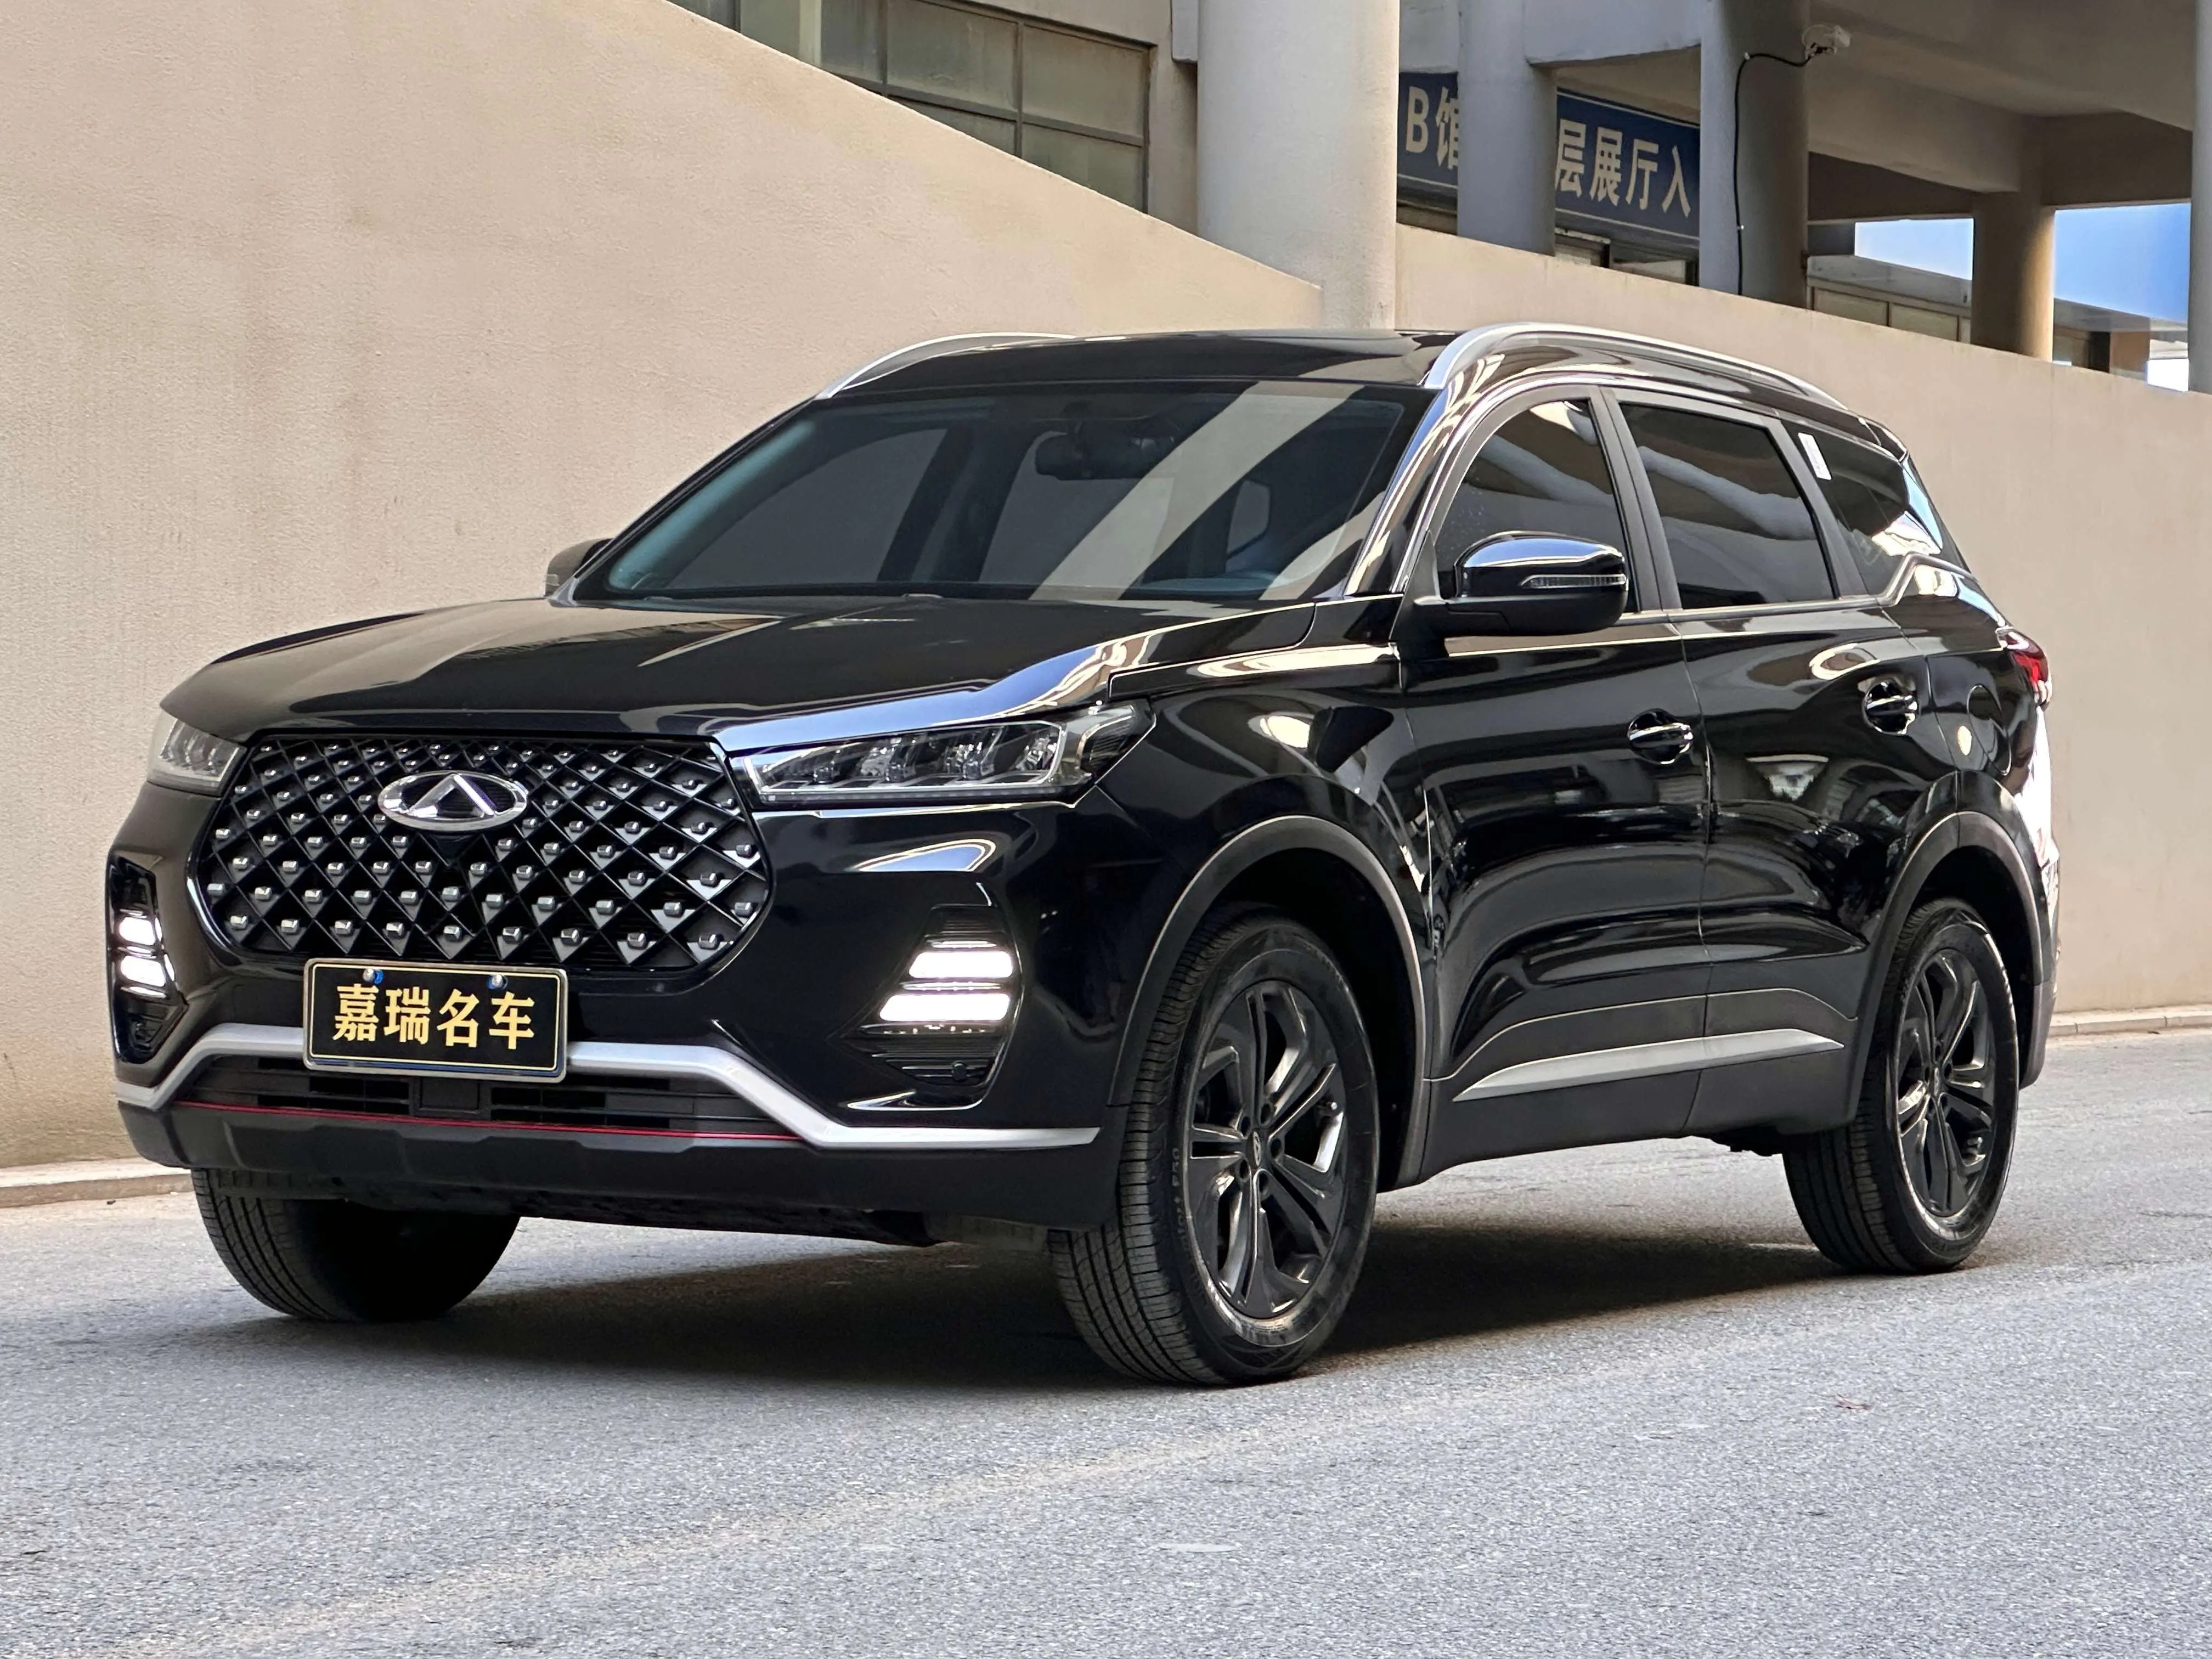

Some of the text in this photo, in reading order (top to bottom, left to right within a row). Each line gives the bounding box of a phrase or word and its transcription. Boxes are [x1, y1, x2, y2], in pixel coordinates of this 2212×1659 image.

[1555, 118, 1691, 218] 层展厅入
[333, 983, 535, 1050] 嘉瑞名车
